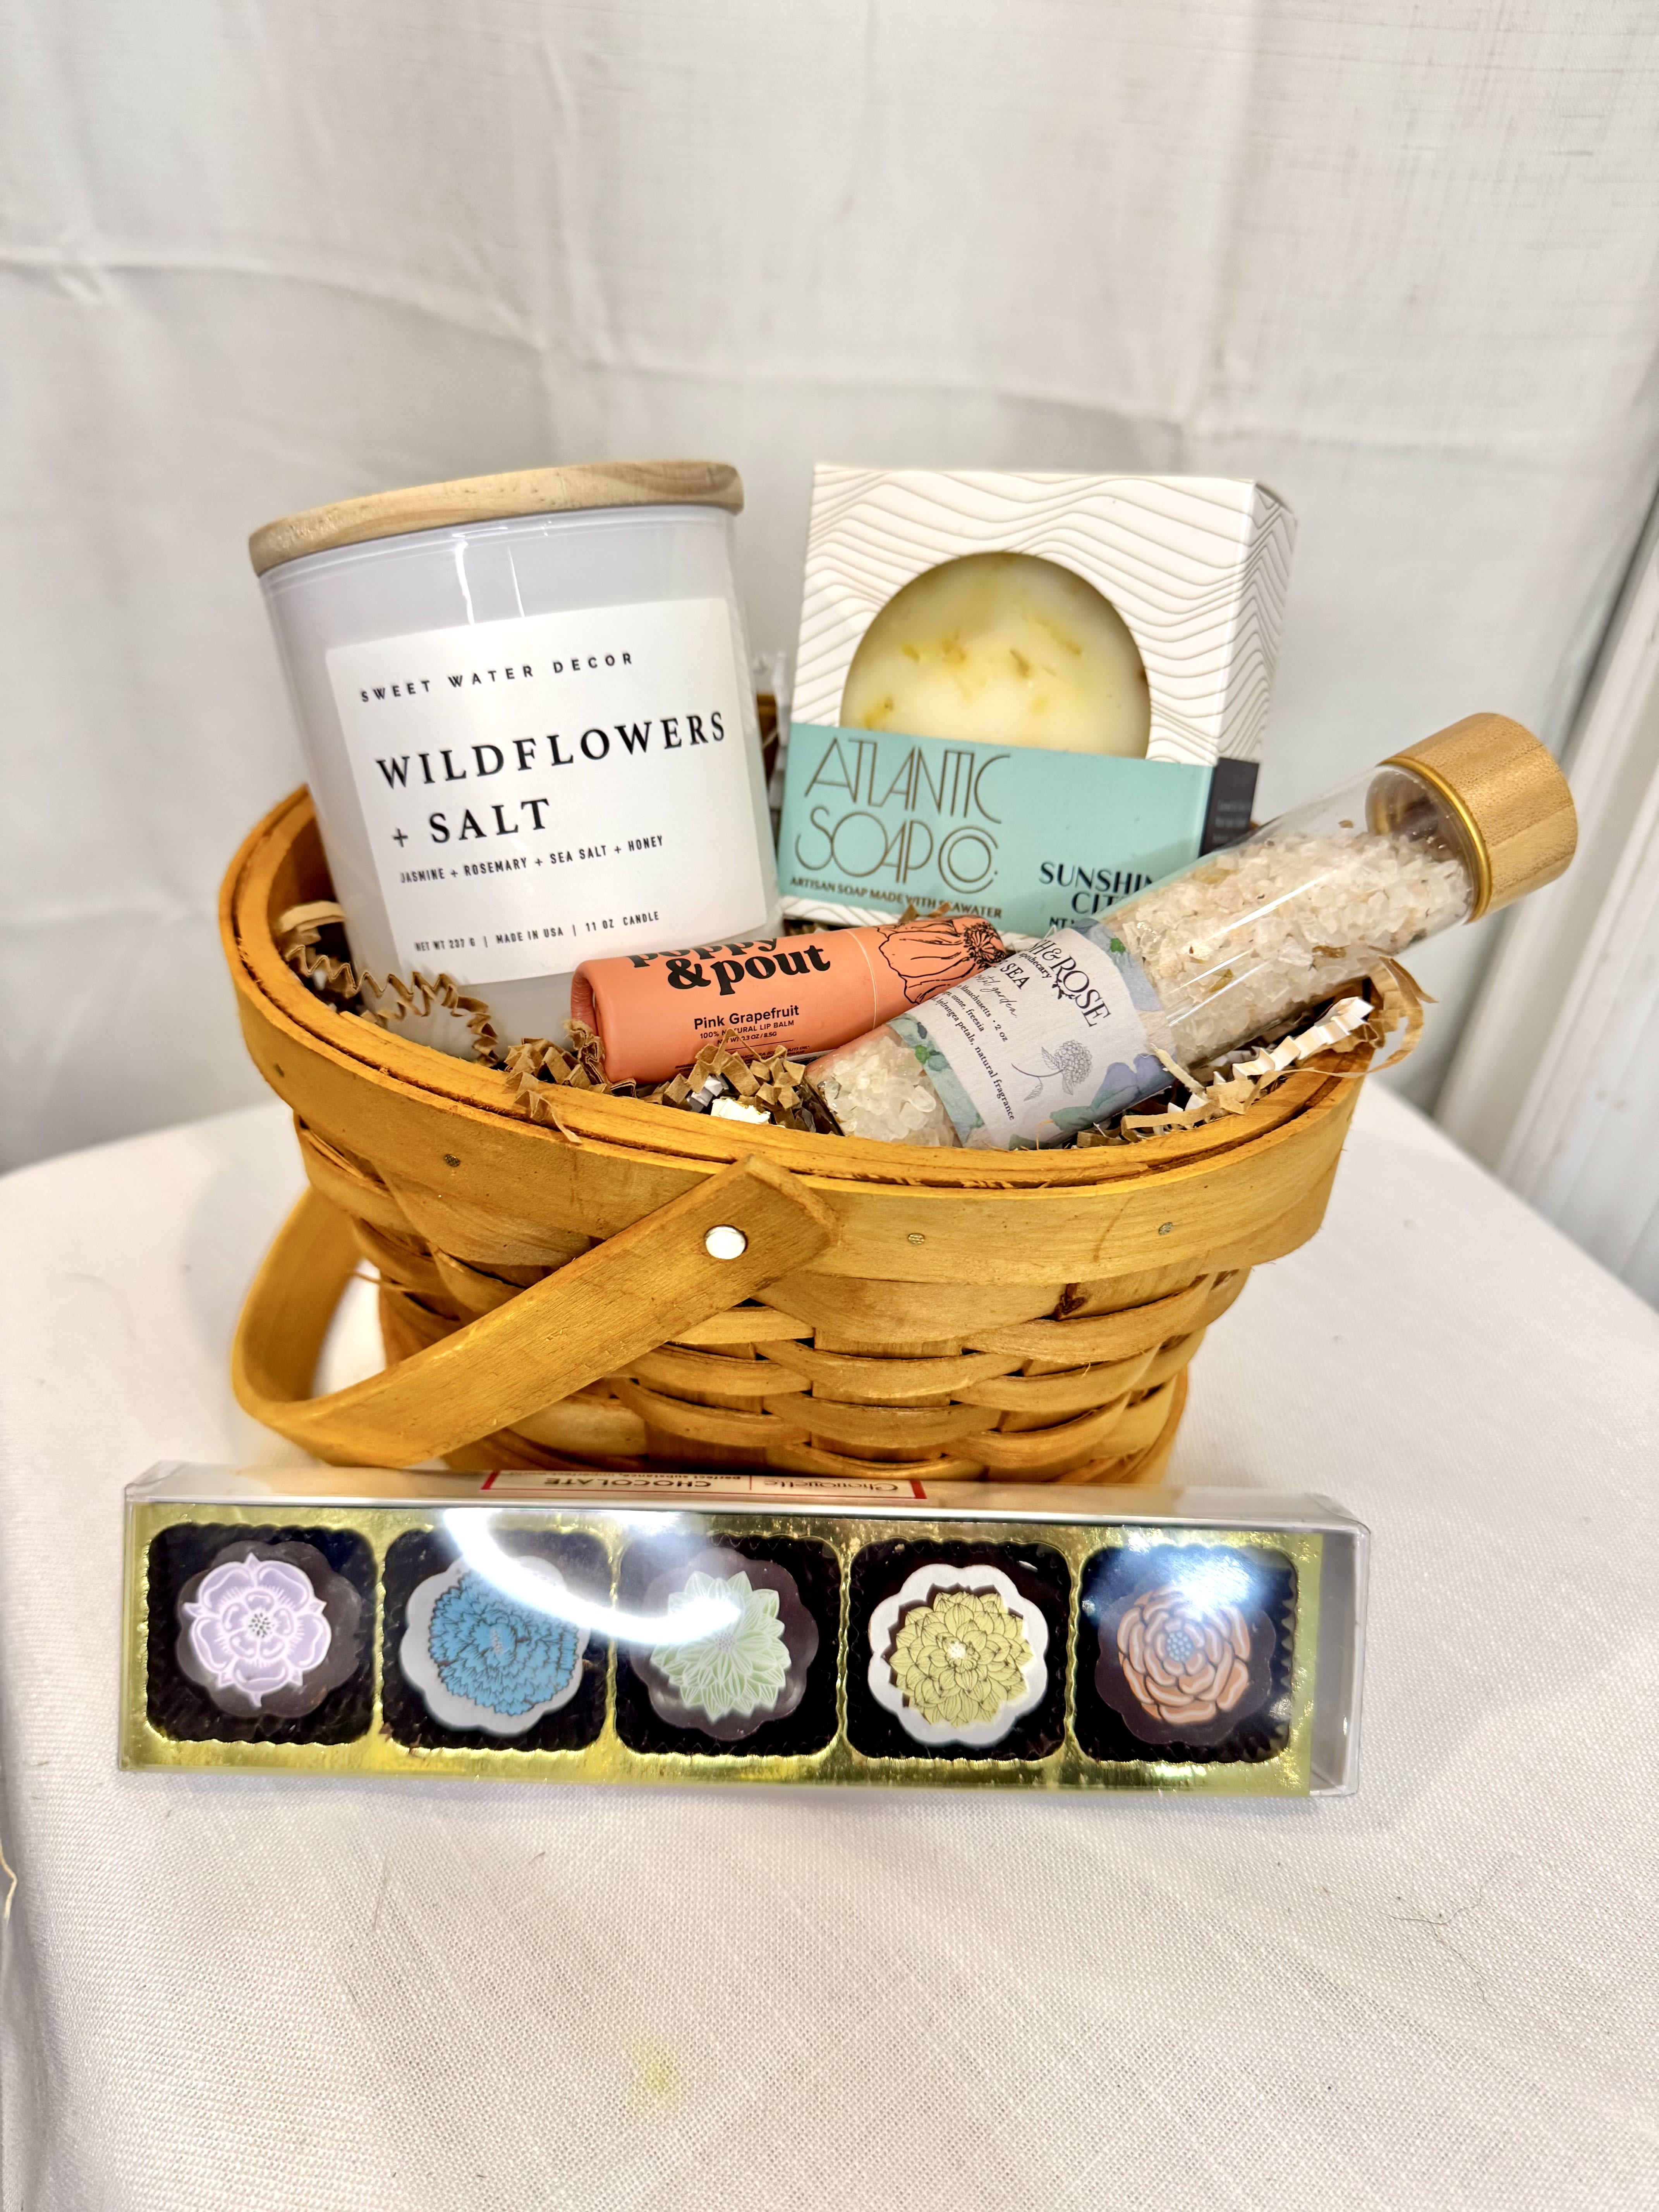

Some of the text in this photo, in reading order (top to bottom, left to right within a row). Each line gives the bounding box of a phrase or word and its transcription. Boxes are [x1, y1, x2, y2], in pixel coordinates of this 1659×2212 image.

[361, 653, 632, 702] SWEET WATER DECOR
[376, 711, 725, 789] WILDFLOWERS
[804, 737, 1011, 824] ATLANTIC
[393, 798, 550, 848] + SALT
[400, 868, 445, 883] JASMINE
[464, 857, 527, 876] ROSEMARY
[550, 851, 573, 864] SEA
[579, 845, 607, 860] SALT
[628, 835, 663, 852] HONEY
[795, 805, 934, 884] SOAP
[790, 877, 1002, 918] ARTISAN SOAP MADE WITH AWATER
[496, 927, 564, 944] MADE IN USA
[586, 911, 659, 932] 11 OZ CANDLE
[1000, 963, 1030, 990] SEA
[694, 1005, 799, 1030] Pink Grapefruit
[700, 1030, 720, 1039] 100%
[722, 1025, 757, 1037] NURAL
[774, 1020, 794, 1028] BALM
[966, 1009, 985, 1032] freesia
[1000, 1032, 1008, 1042] oz
[955, 1021, 975, 1046] petals,
[974, 1046, 998, 1078] natural
[993, 1079, 1015, 1121] fragrance
[544, 1478, 711, 1487] CHOCOLATE
